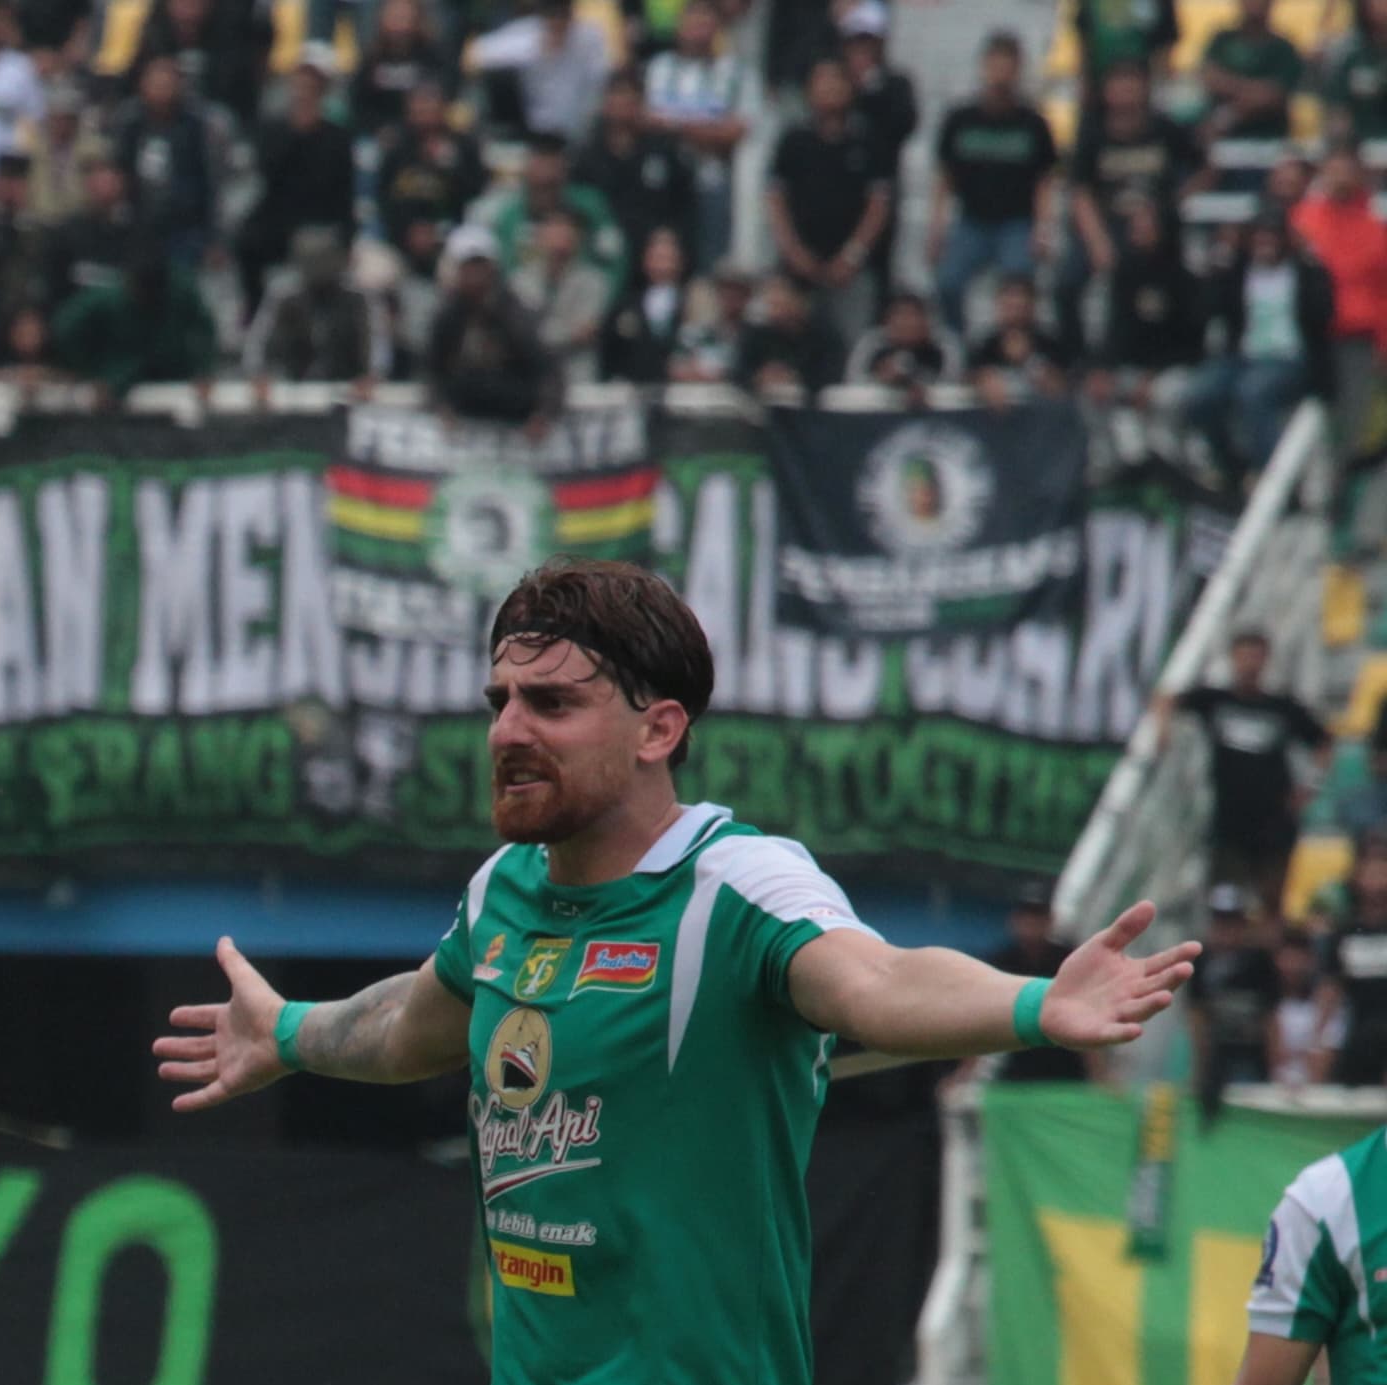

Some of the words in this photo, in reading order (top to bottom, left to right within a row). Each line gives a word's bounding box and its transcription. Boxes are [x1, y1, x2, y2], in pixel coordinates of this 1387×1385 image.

[528, 1086, 603, 1166] Api
[498, 1210, 536, 1240] lebih
[539, 1219, 598, 1247] enak
[495, 1249, 565, 1288] tangin
